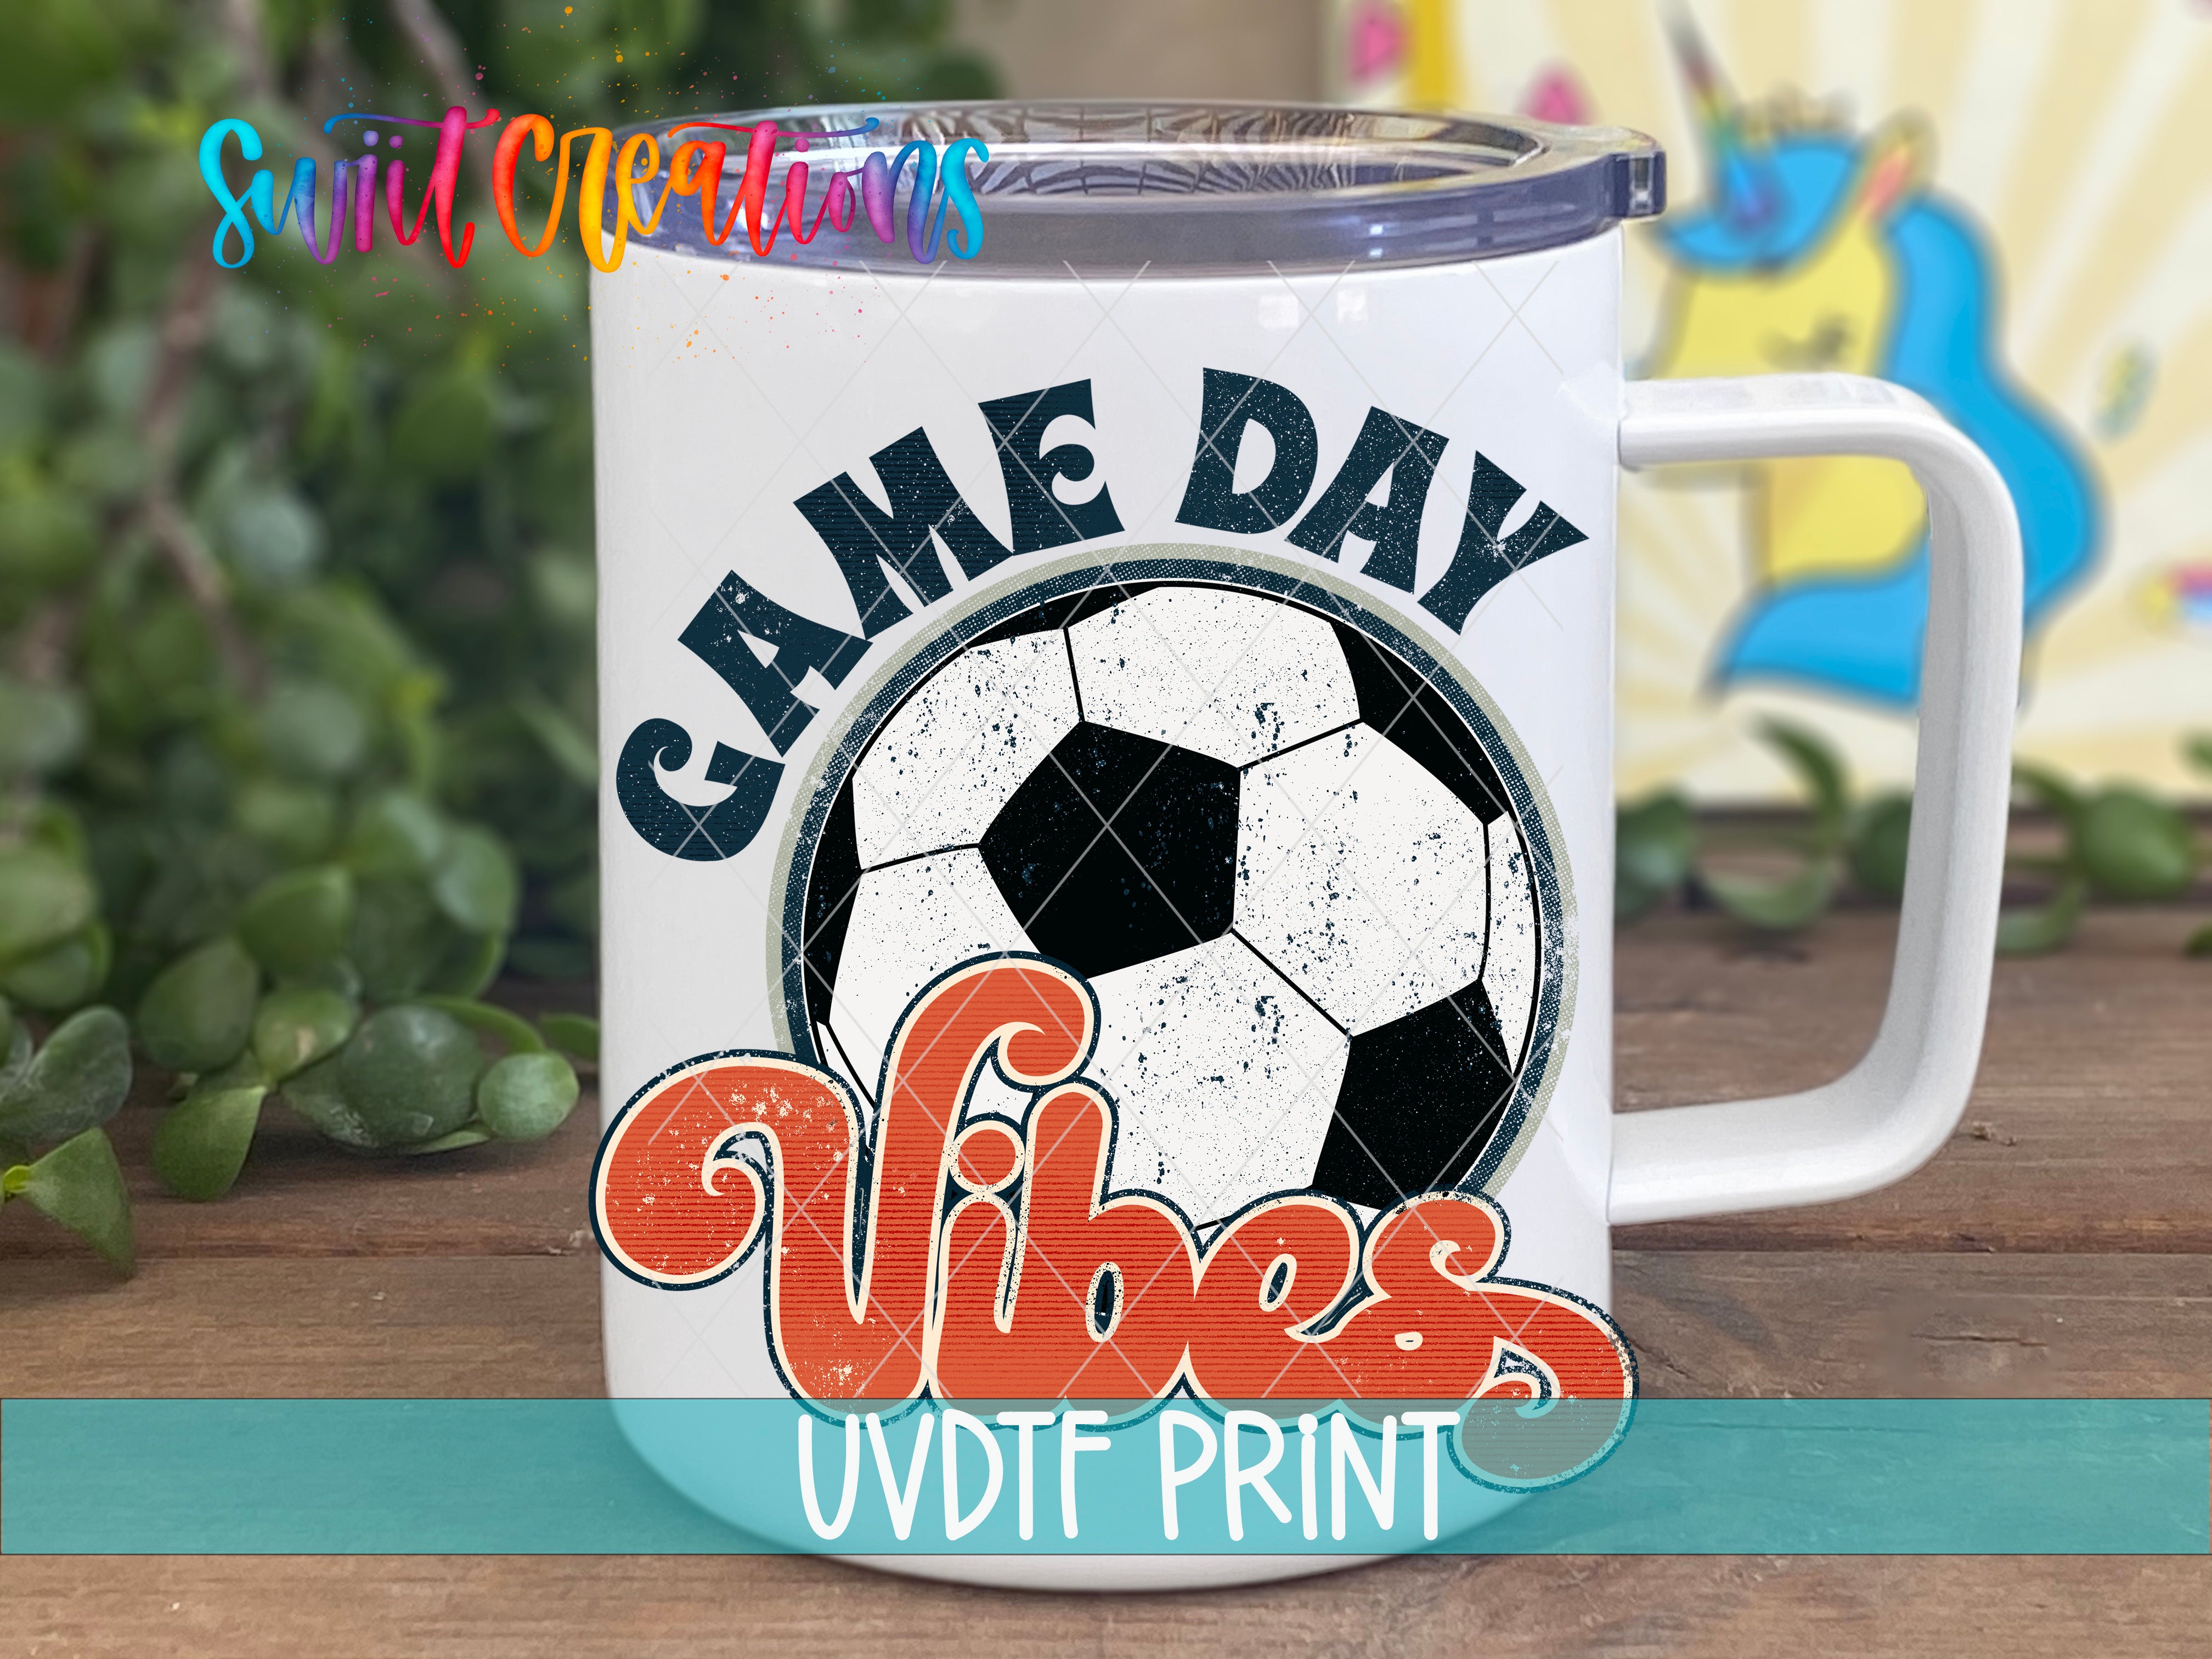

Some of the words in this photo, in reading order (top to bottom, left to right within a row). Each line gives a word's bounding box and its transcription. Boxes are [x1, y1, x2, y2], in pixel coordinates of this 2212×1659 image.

[616, 379, 1125, 862] GAME
[1175, 366, 1589, 635] DAY
[589, 951, 1639, 1492] Vibes
